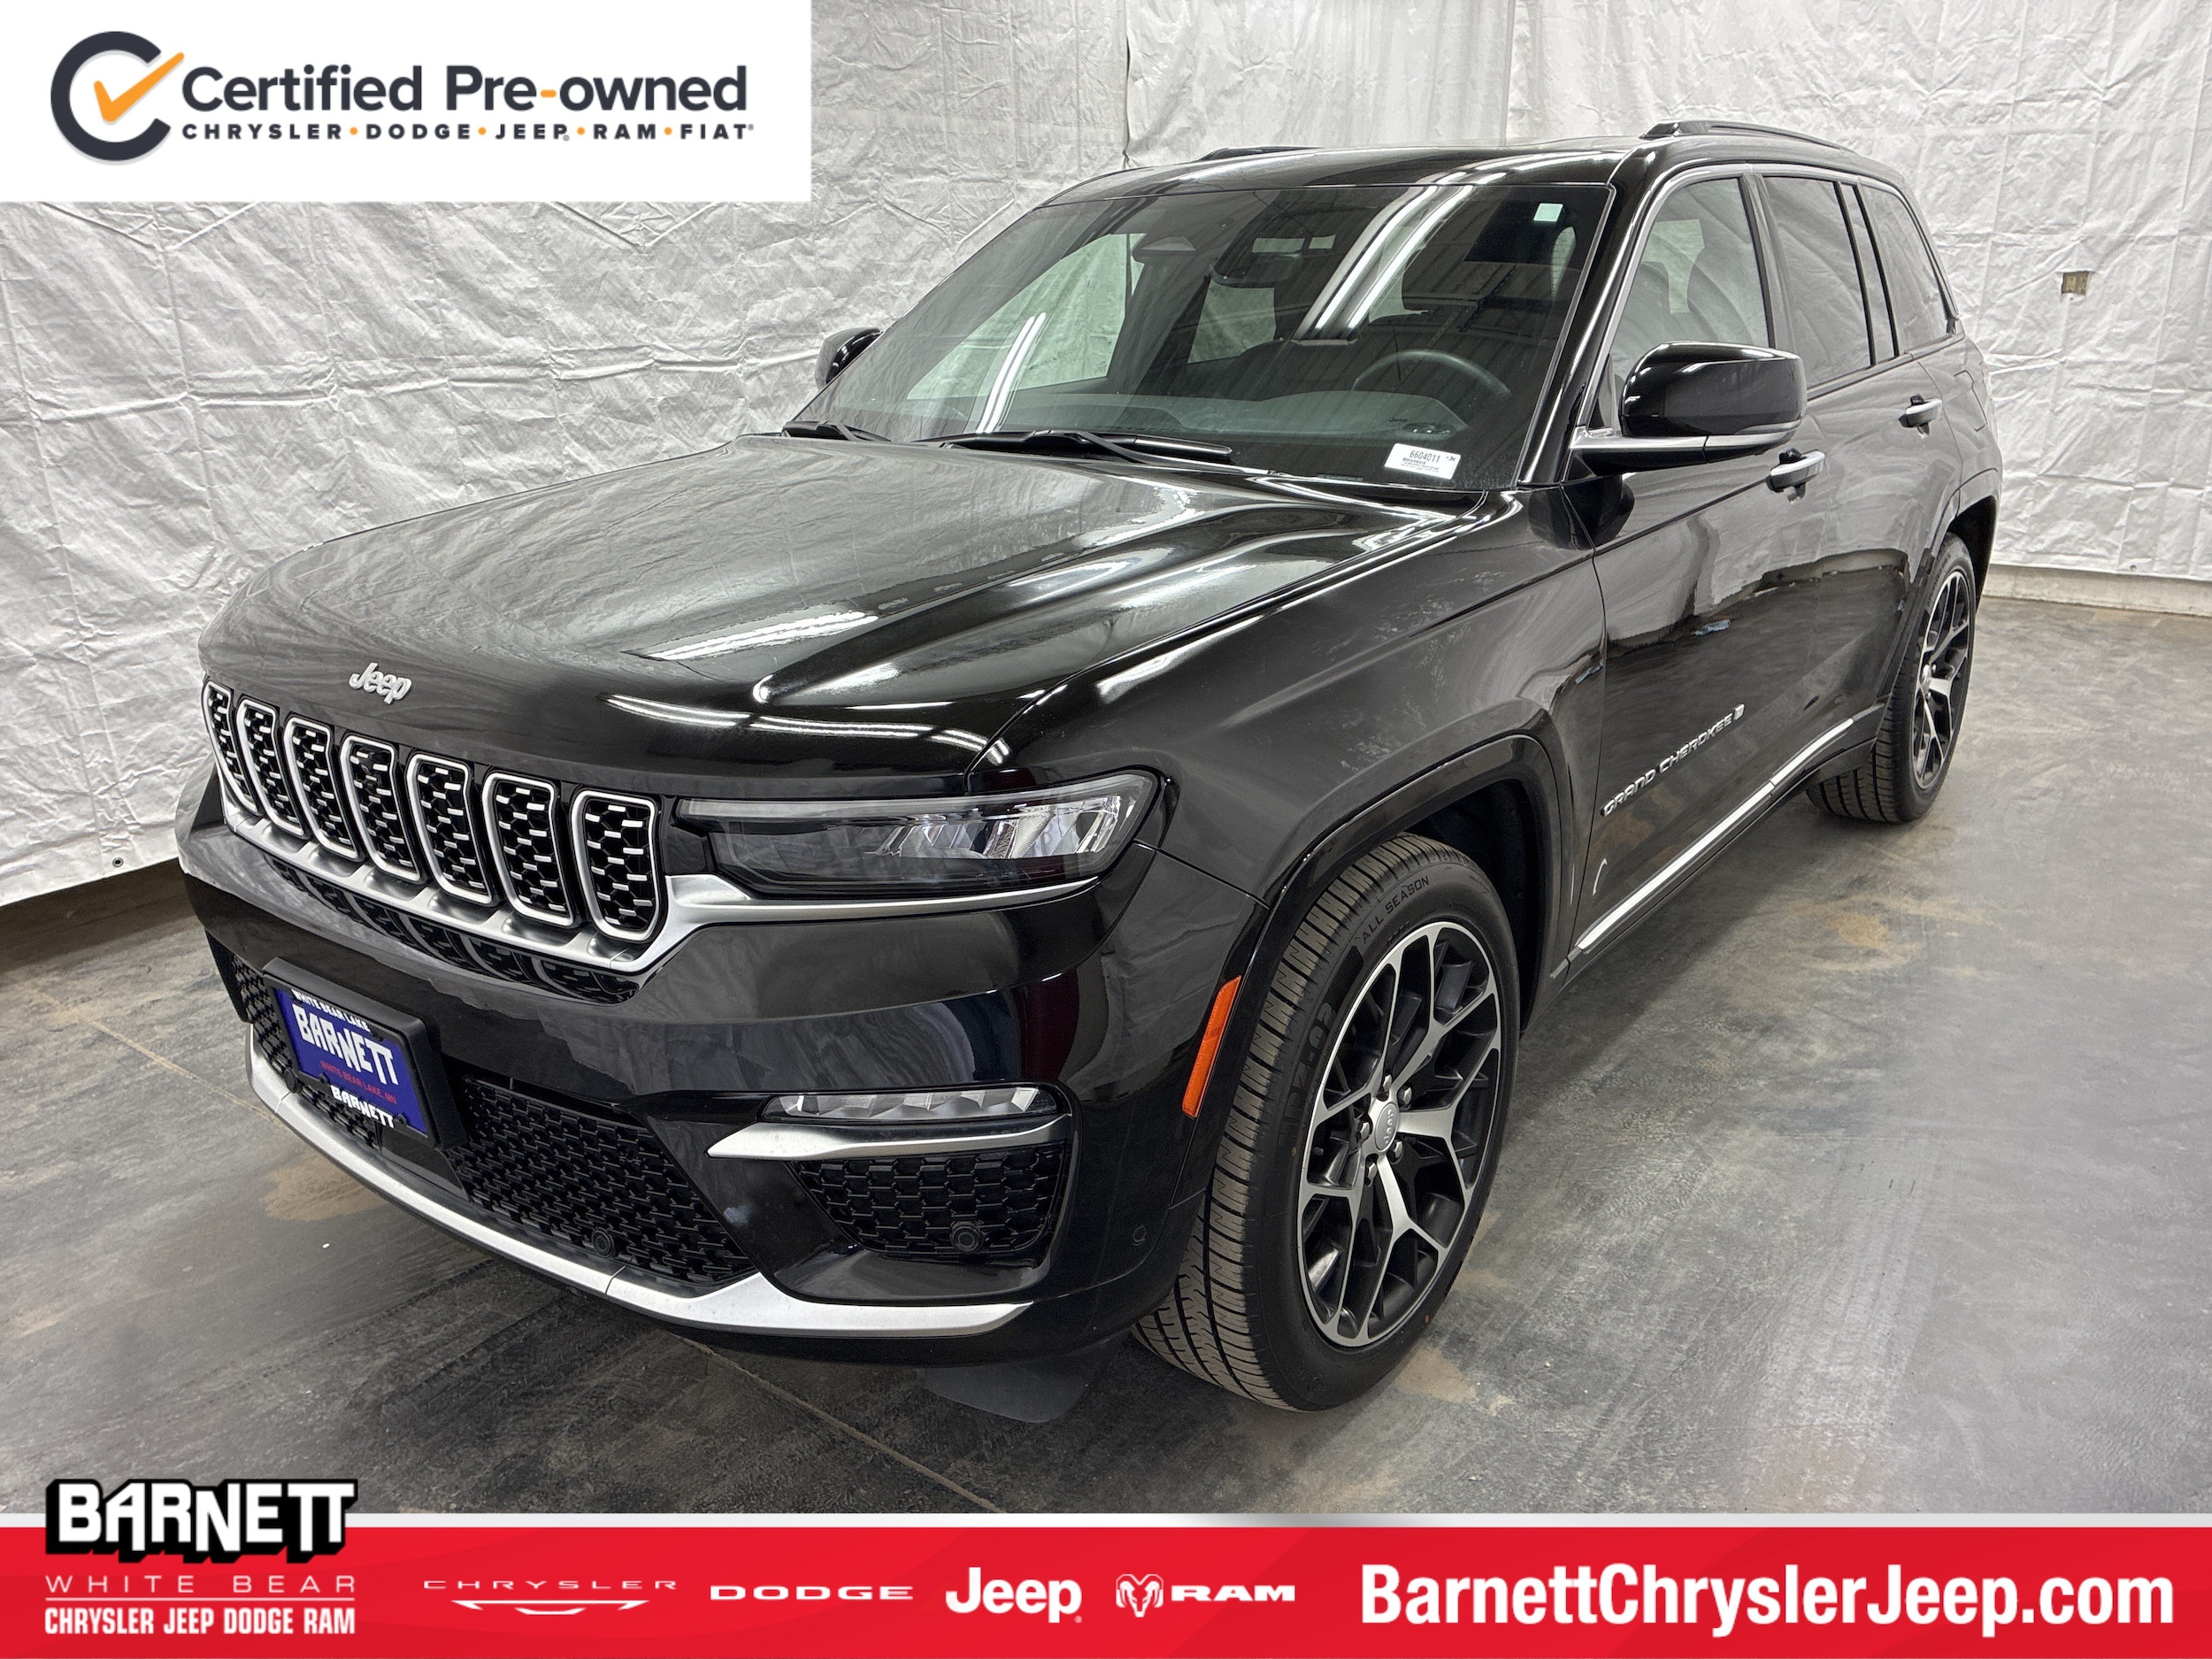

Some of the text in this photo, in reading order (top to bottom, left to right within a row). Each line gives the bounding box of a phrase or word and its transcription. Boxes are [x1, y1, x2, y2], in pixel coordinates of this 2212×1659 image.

[349, 662, 412, 704] Jeep
[1603, 712, 1733, 817] GRAND CHEROKEE
[1361, 916, 1384, 944] ALL
[1386, 875, 1430, 915] SEASON
[292, 1003, 399, 1086] BARNETT
[330, 1085, 395, 1129] BARNETT
